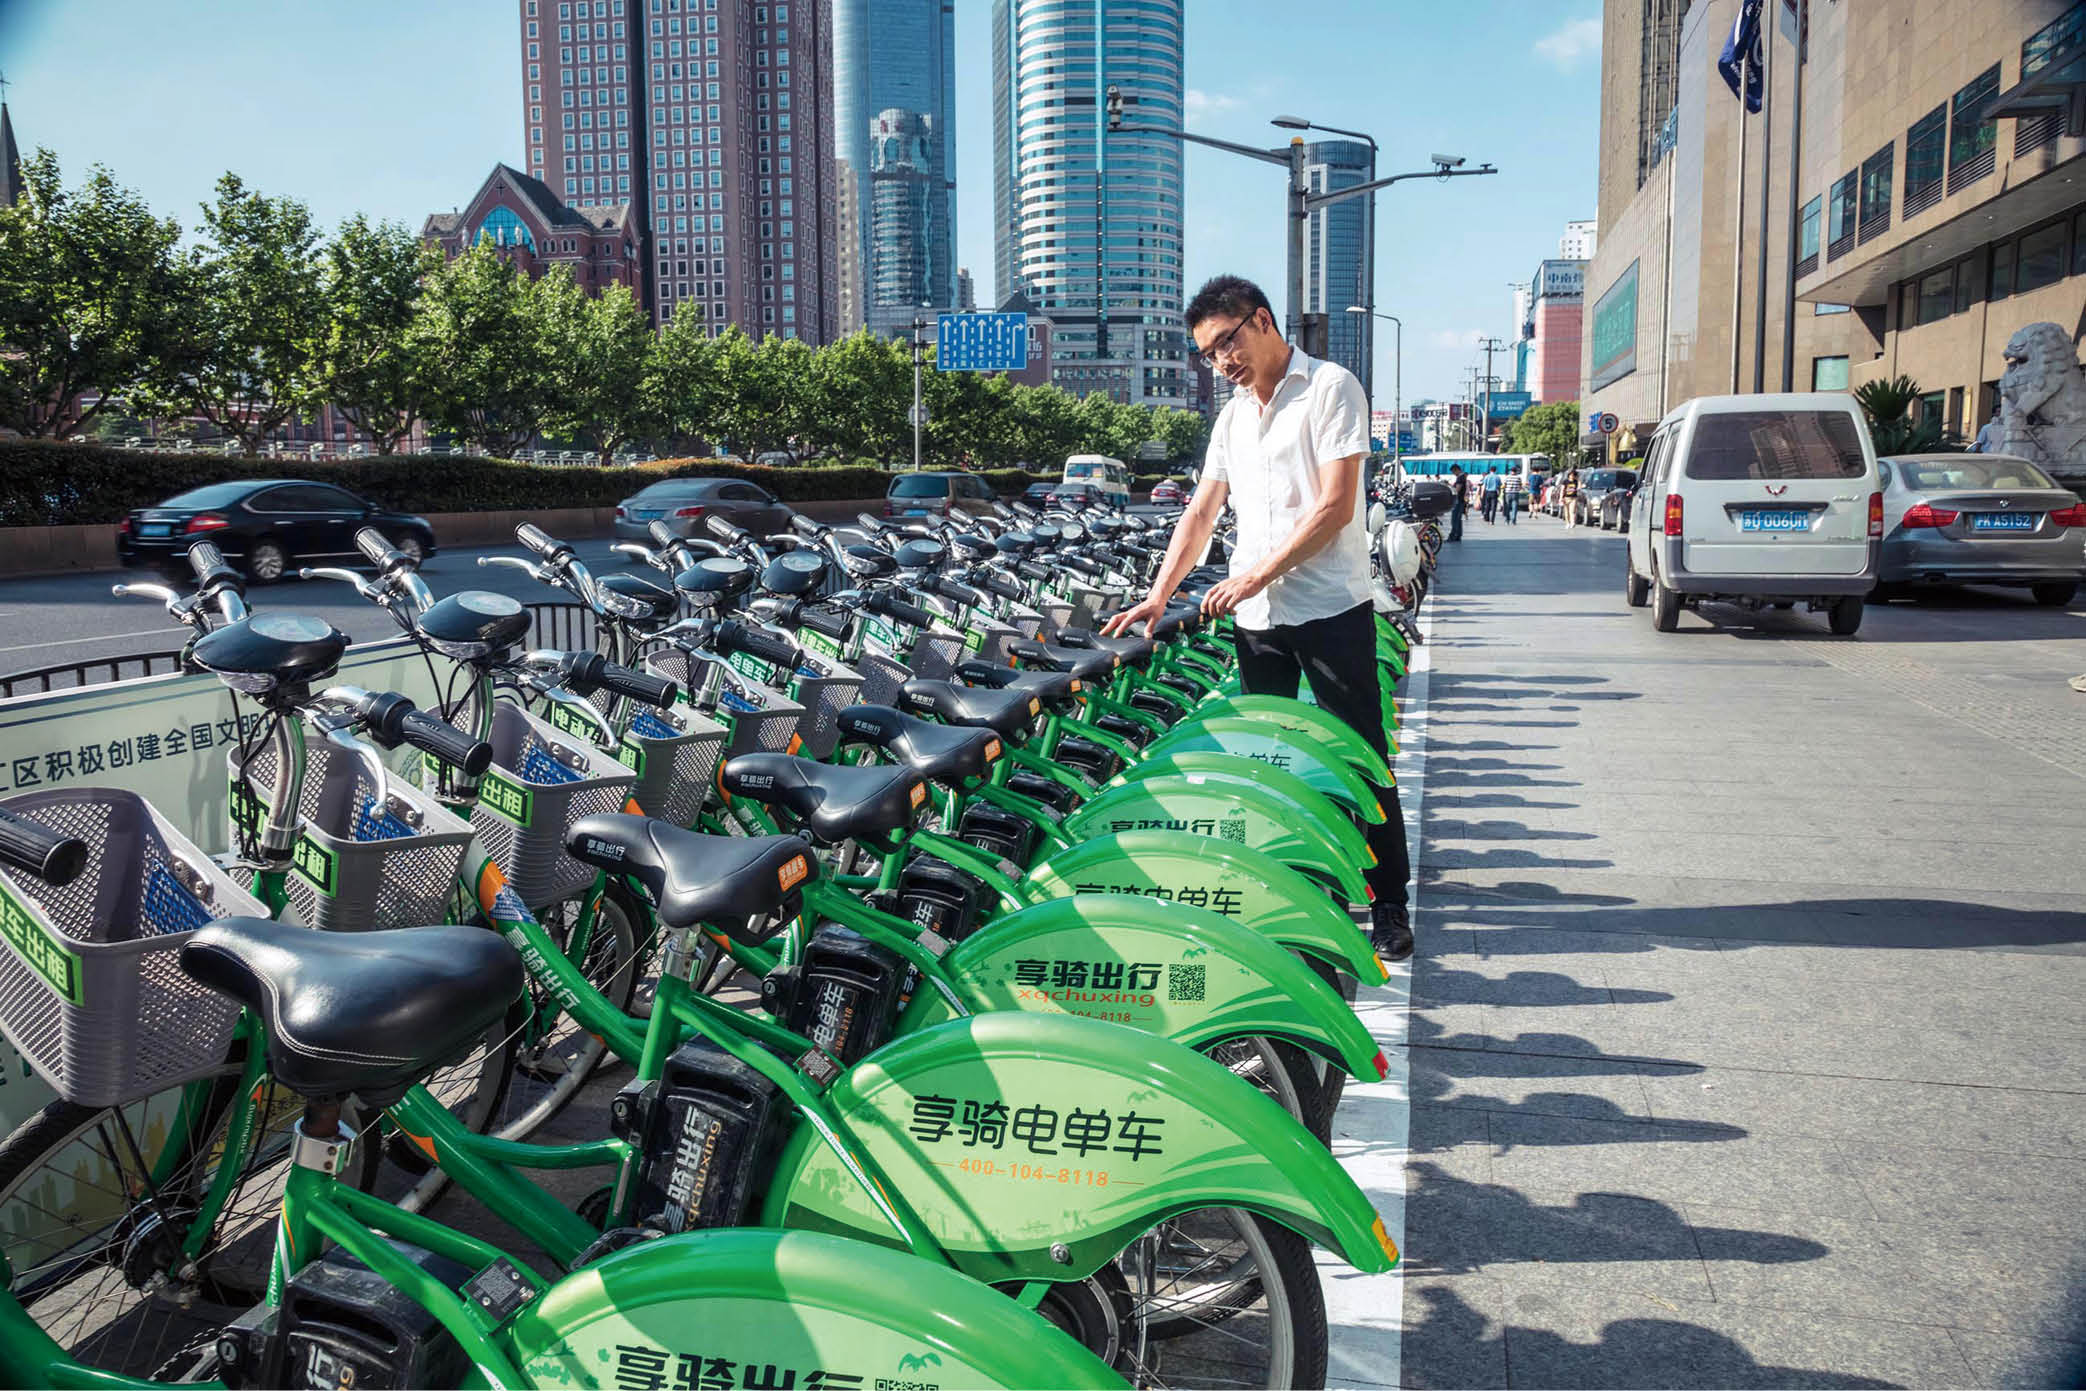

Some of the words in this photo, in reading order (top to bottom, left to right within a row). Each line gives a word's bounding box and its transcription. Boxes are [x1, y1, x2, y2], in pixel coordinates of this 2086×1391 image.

[1604, 417, 1613, 430] 5
[0, 712, 276, 792] 区积极创建全国文明
[0, 899, 69, 992] 车出租
[1014, 959, 1163, 991] 享骑出行
[1018, 988, 1156, 1008] xqchuxing
[909, 1095, 1166, 1163] 享骑电单车
[958, 1157, 1110, 1188] 400-104-8118
